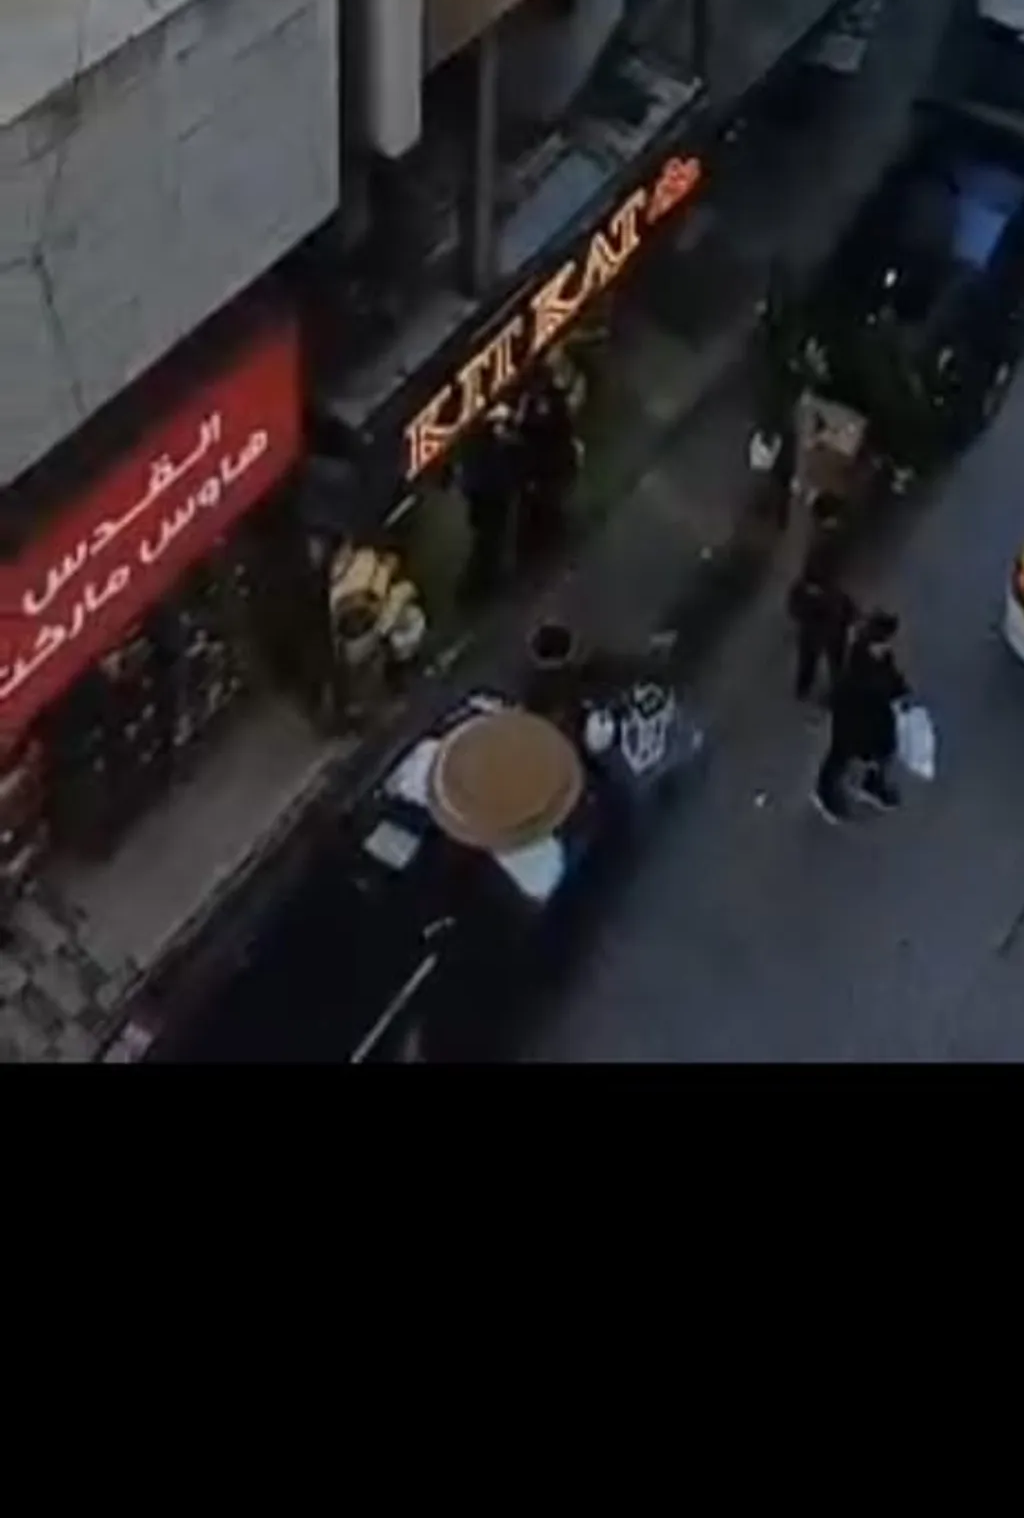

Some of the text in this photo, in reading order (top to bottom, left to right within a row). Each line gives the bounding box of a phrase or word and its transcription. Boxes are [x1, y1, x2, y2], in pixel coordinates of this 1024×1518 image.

[404, 186, 647, 482] KIT KAT
[21, 411, 222, 616] القدس
[139, 427, 268, 565] هاوس
